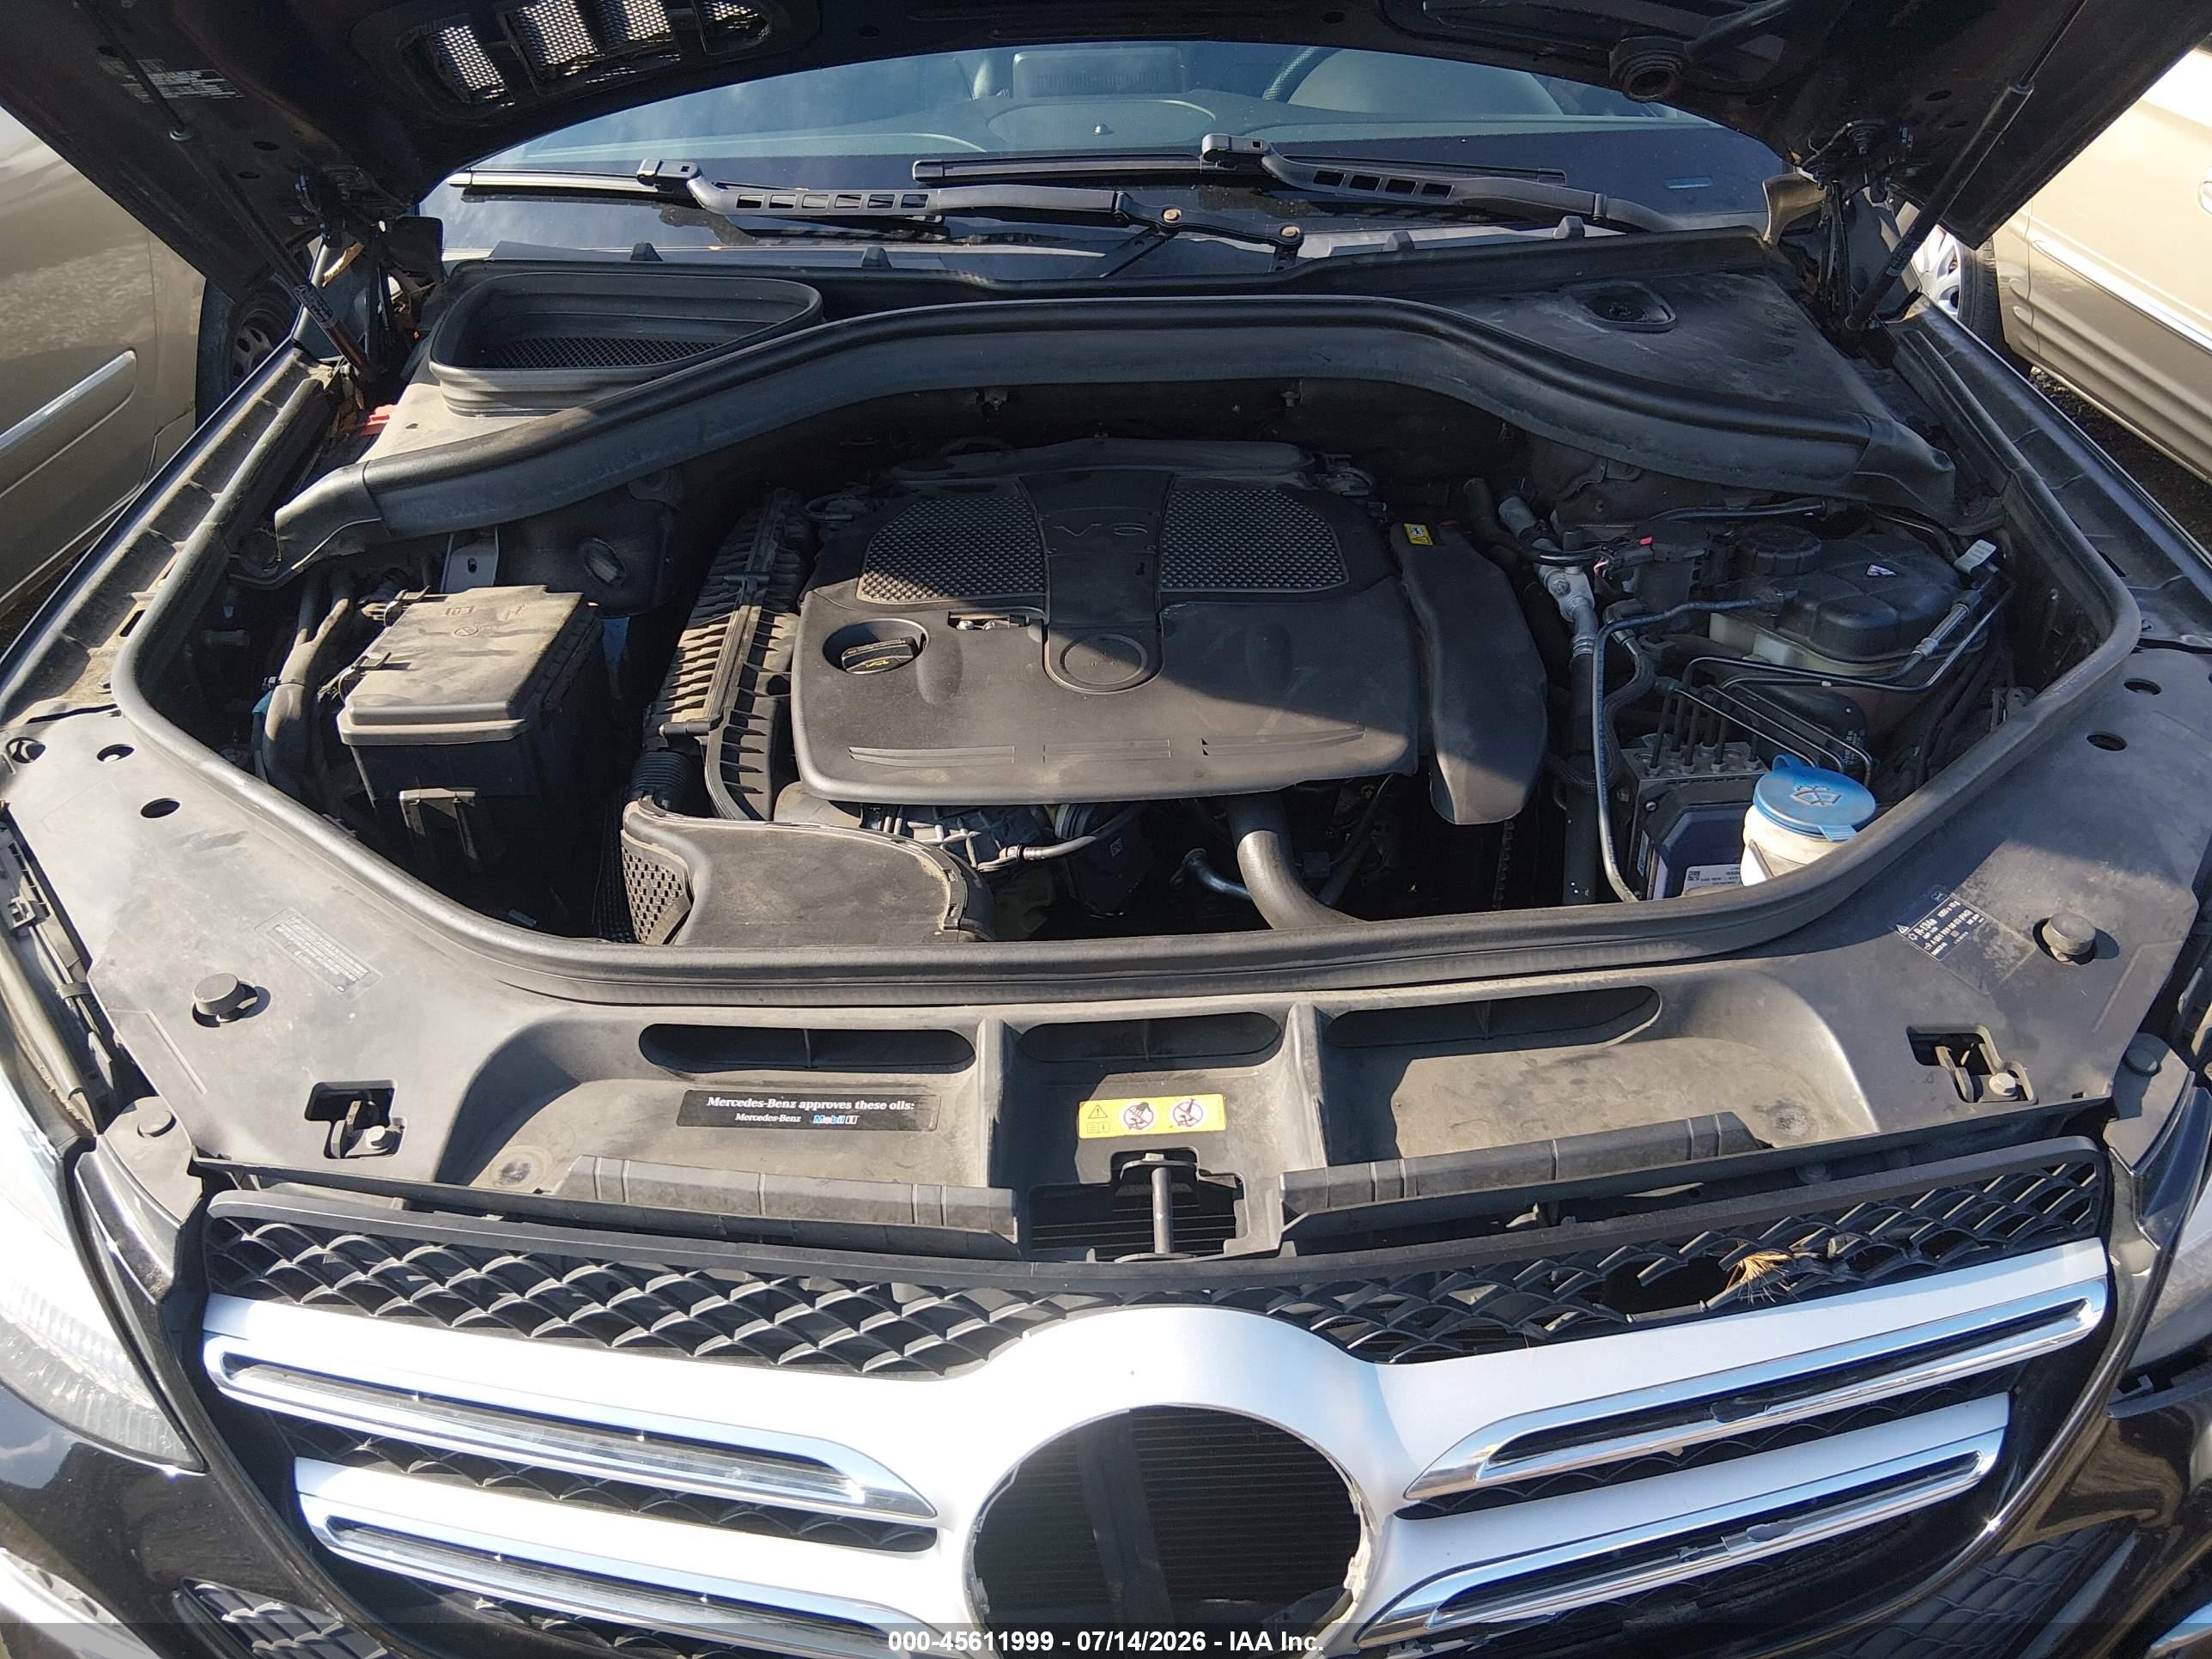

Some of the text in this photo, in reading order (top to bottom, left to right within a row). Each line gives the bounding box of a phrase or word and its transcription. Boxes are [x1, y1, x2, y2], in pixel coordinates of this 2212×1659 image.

[1913, 918, 1938, 936] R-134a
[706, 1097, 915, 1111] Mercedes-Benz approves these oils:
[735, 1113, 801, 1122] Mercedes-Benz
